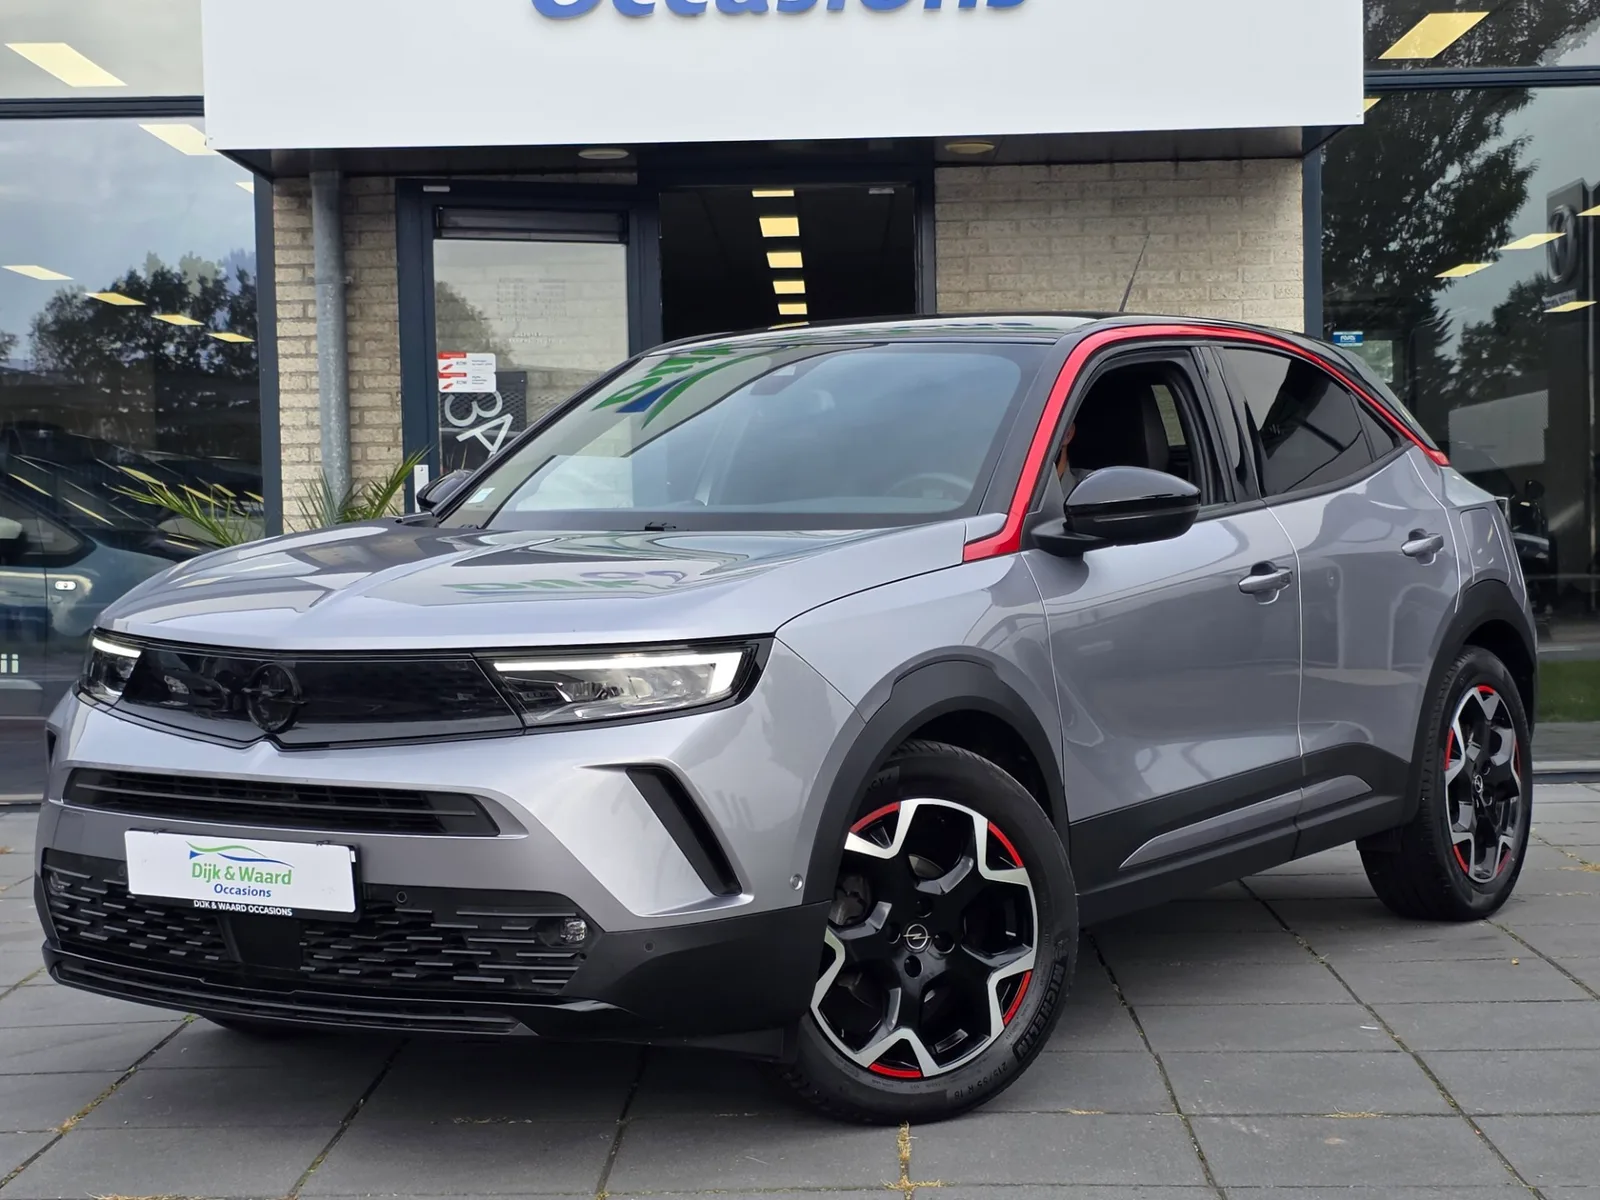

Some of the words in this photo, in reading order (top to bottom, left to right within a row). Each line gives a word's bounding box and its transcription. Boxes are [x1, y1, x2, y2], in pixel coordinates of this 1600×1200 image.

[192, 862, 221, 883] Dijk
[224, 866, 235, 880] &
[239, 866, 292, 885] Waard
[214, 883, 272, 898] Occasions
[194, 900, 210, 909] DIJK
[211, 901, 217, 909] &
[218, 902, 247, 913] WAARD
[248, 905, 293, 917] OCCASIONS
[1016, 962, 1066, 1059] MICHELIN
